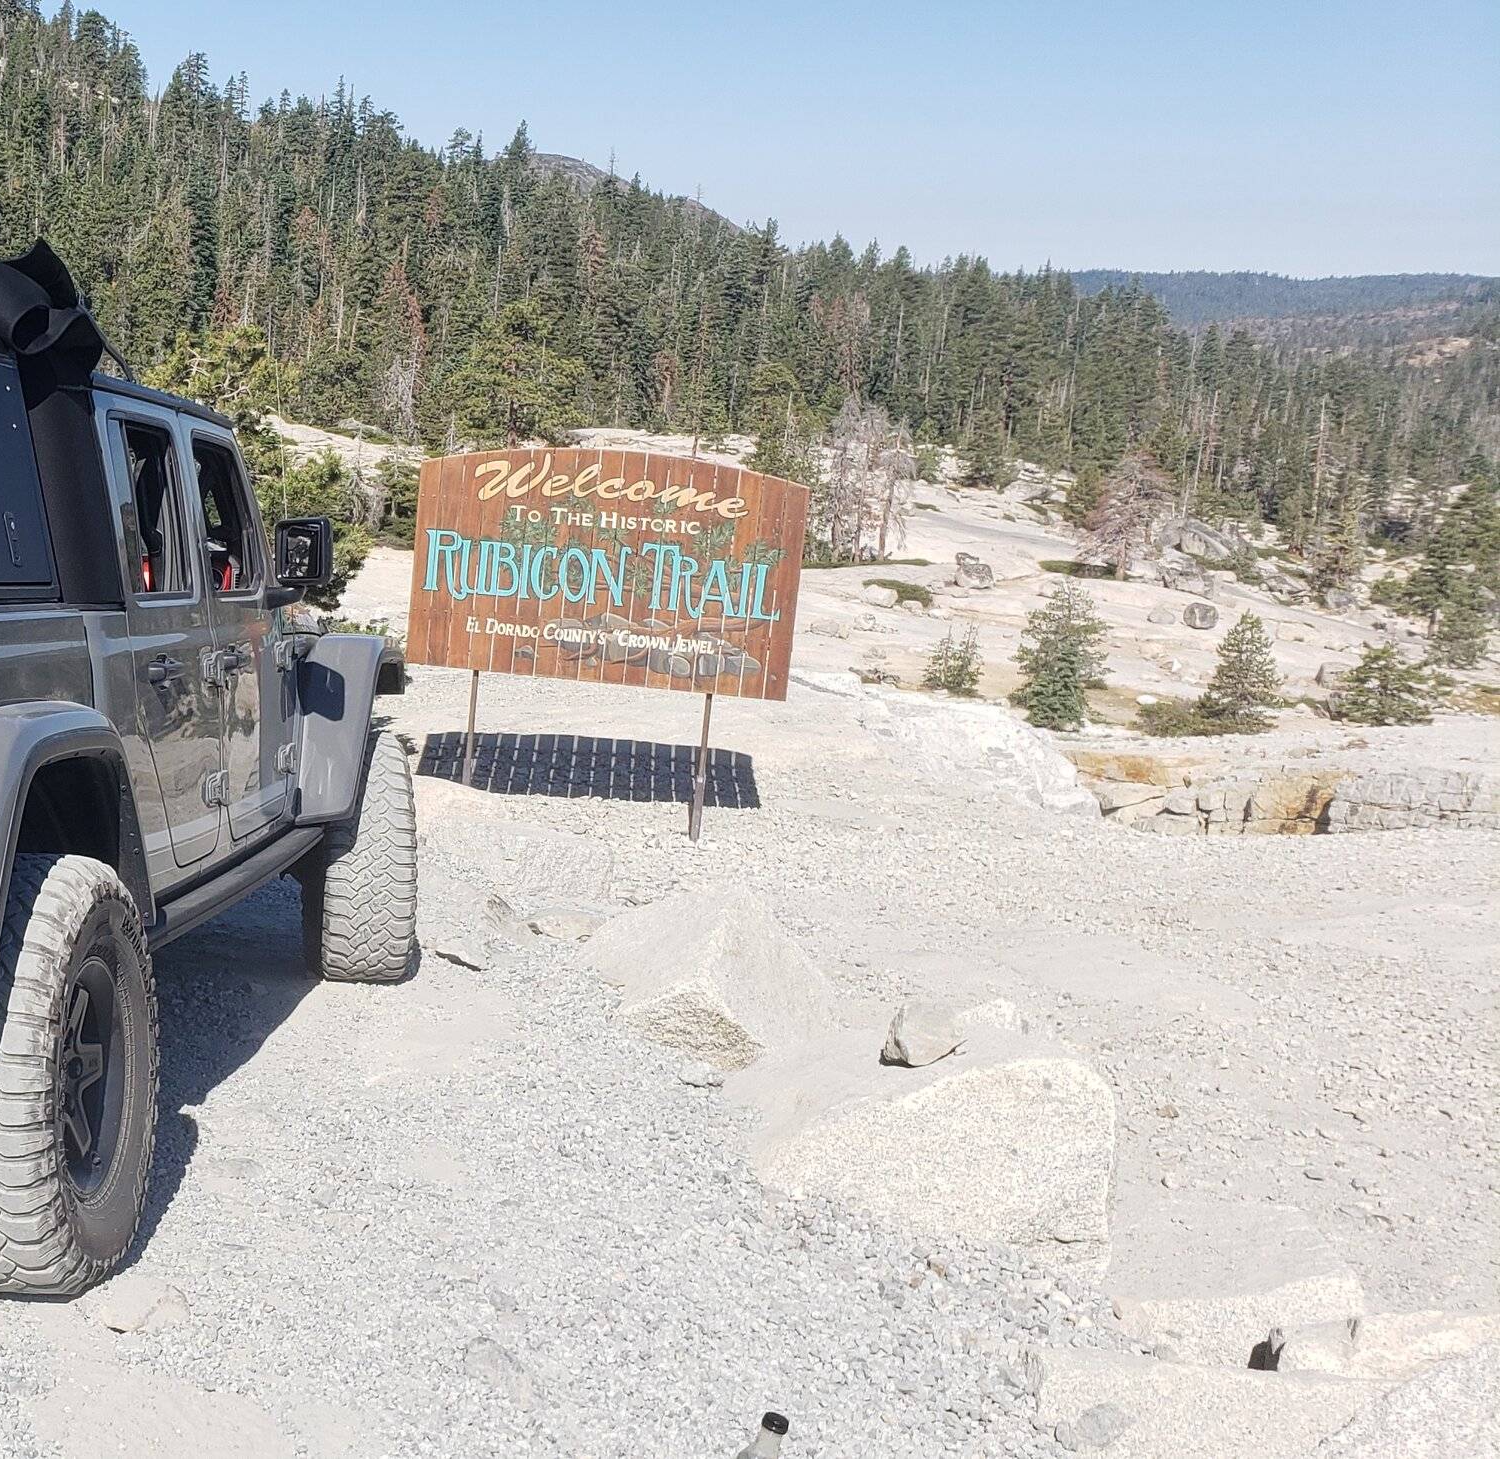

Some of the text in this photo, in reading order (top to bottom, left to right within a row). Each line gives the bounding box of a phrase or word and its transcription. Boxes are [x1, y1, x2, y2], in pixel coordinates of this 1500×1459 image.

[473, 453, 750, 519] Welcome
[551, 506, 594, 528] THE
[599, 510, 701, 535] HISTORIC
[421, 528, 781, 622] RUBICON TRAIL
[465, 615, 481, 634] EL
[485, 617, 540, 639] DORADO
